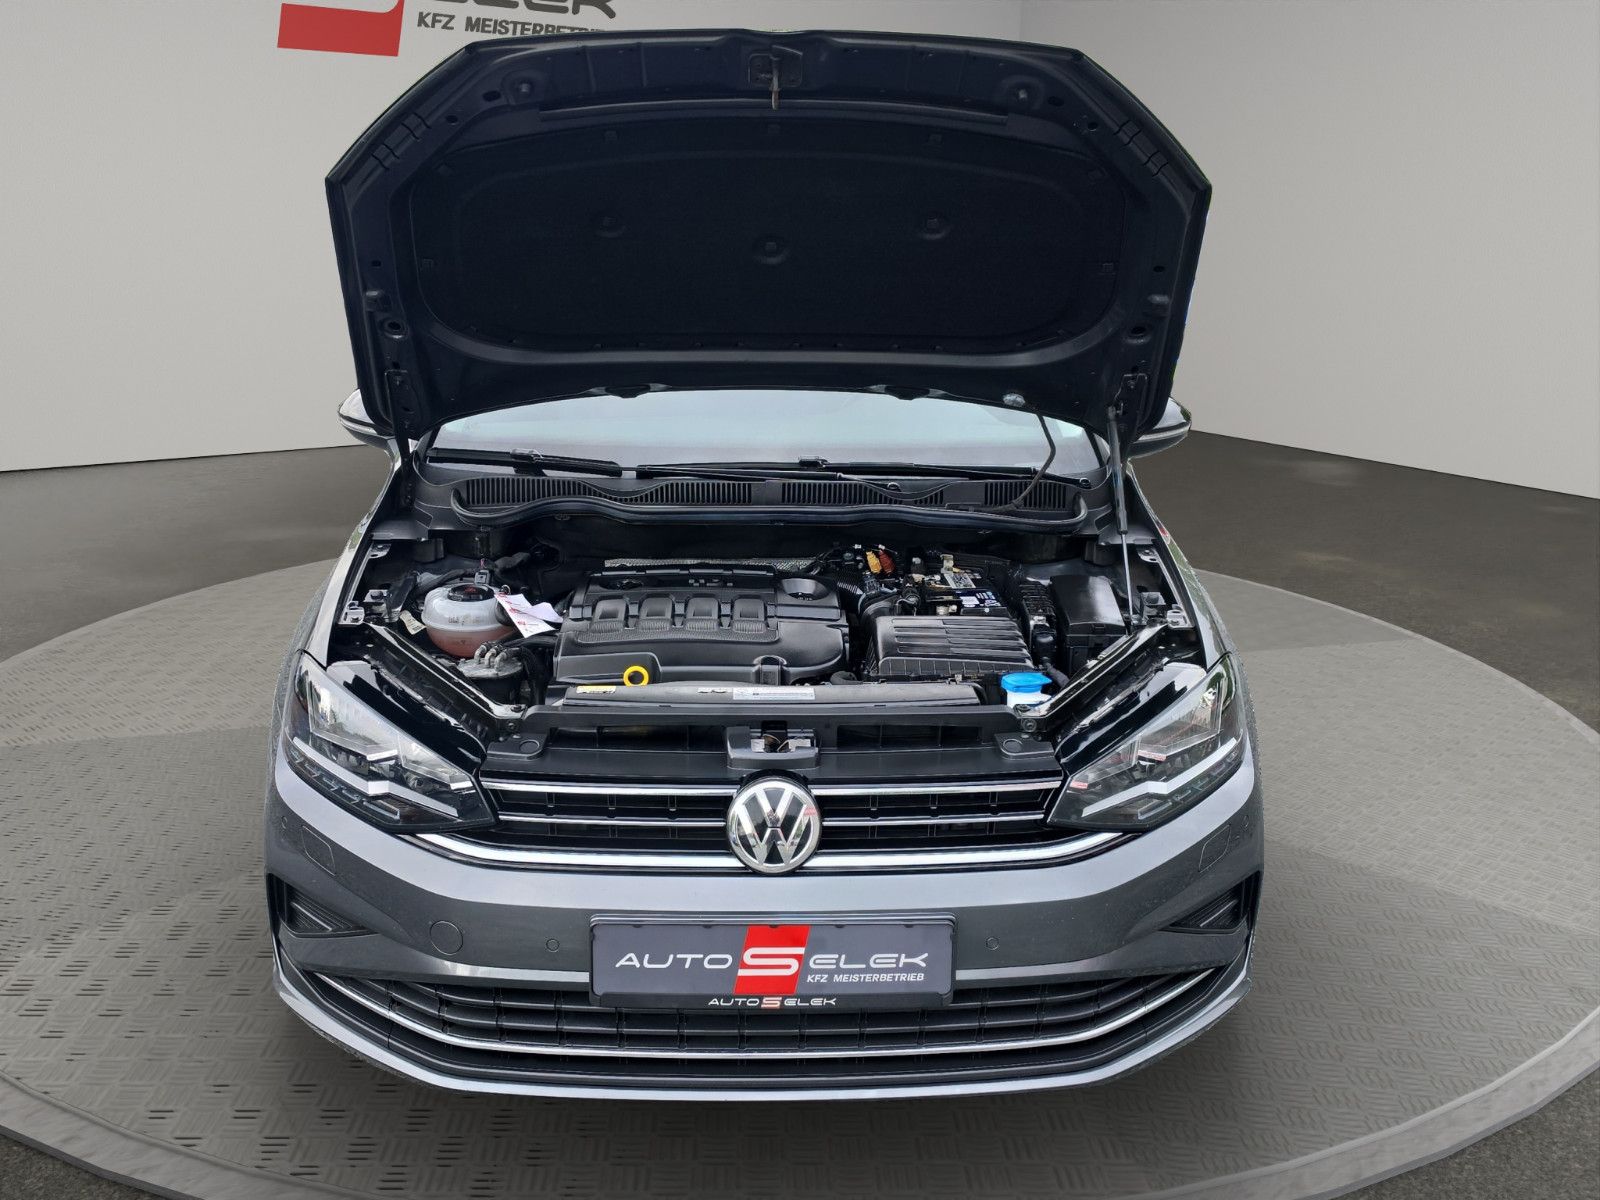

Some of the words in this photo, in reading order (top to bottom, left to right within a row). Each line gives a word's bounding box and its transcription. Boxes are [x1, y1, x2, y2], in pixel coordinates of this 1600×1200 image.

[417, 11, 456, 30] KFZ
[464, 16, 605, 36] MEISTERB
[806, 974, 829, 983] KFZ
[833, 972, 925, 983] MEISTERBETRIEB
